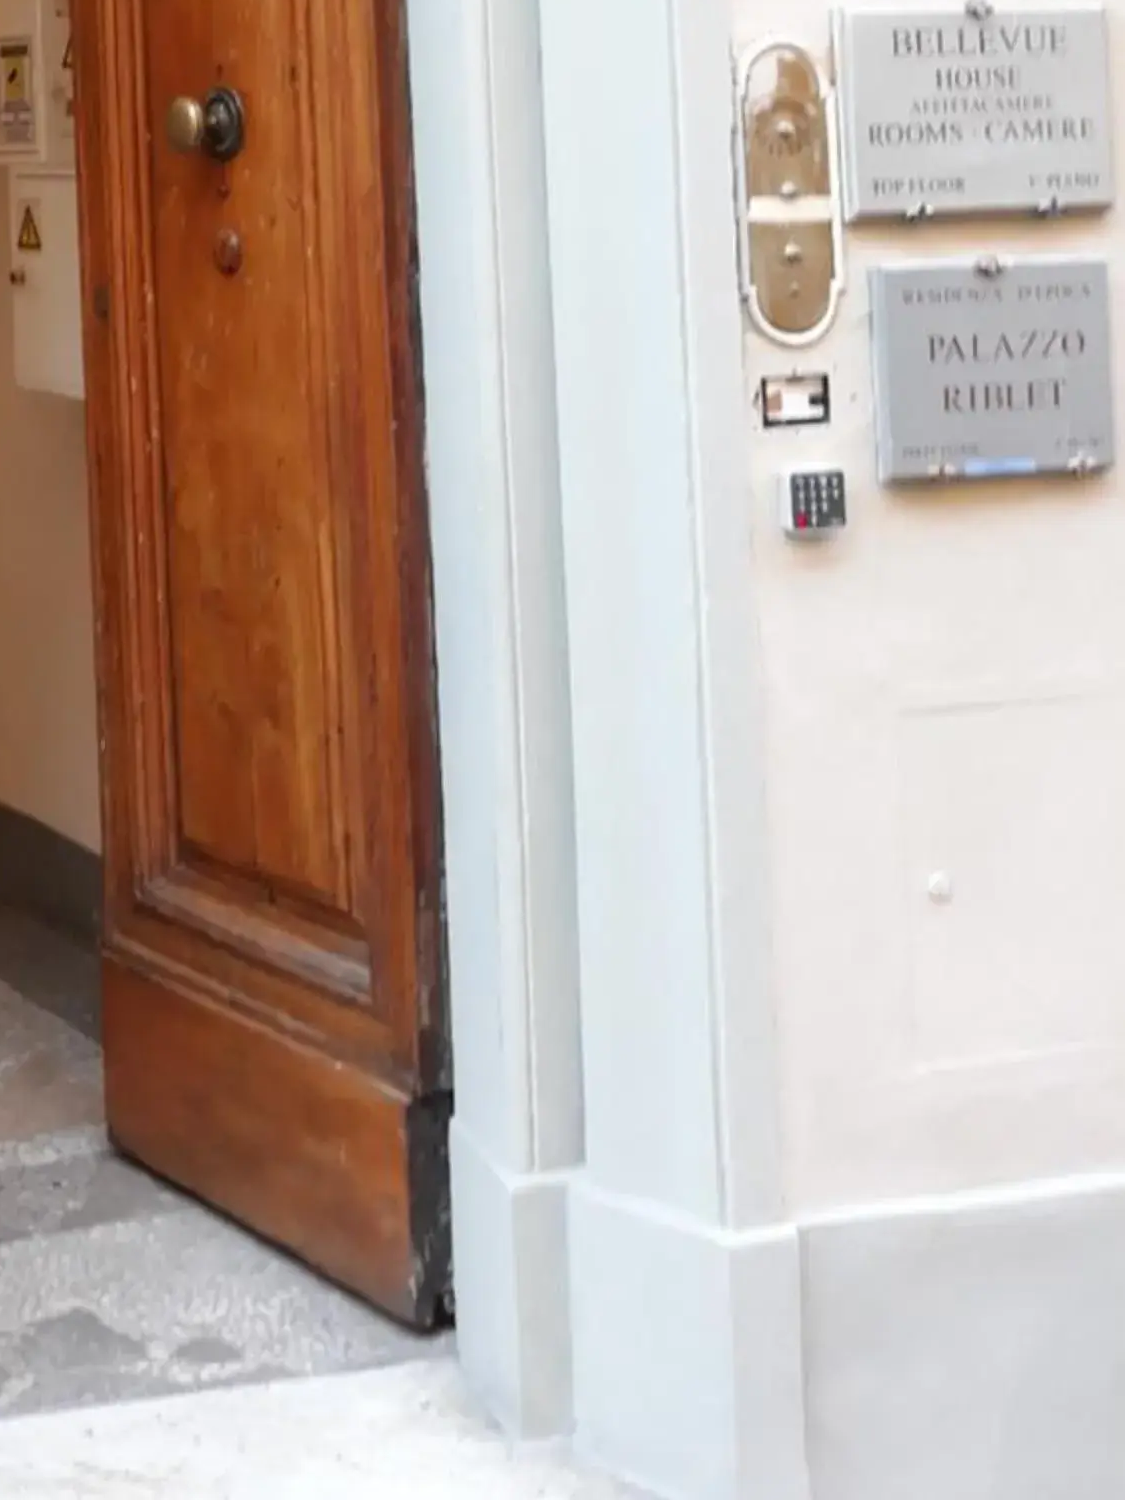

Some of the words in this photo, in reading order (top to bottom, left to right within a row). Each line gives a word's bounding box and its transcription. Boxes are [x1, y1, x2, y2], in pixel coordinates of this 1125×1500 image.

[892, 25, 1067, 57] BELLEVUE
[935, 67, 1021, 91] HOUSE
[869, 121, 963, 146] ROOMS
[983, 117, 1094, 143] CAMERE
[927, 328, 1086, 365] PALAZZO
[943, 377, 1067, 414] RIBLET
